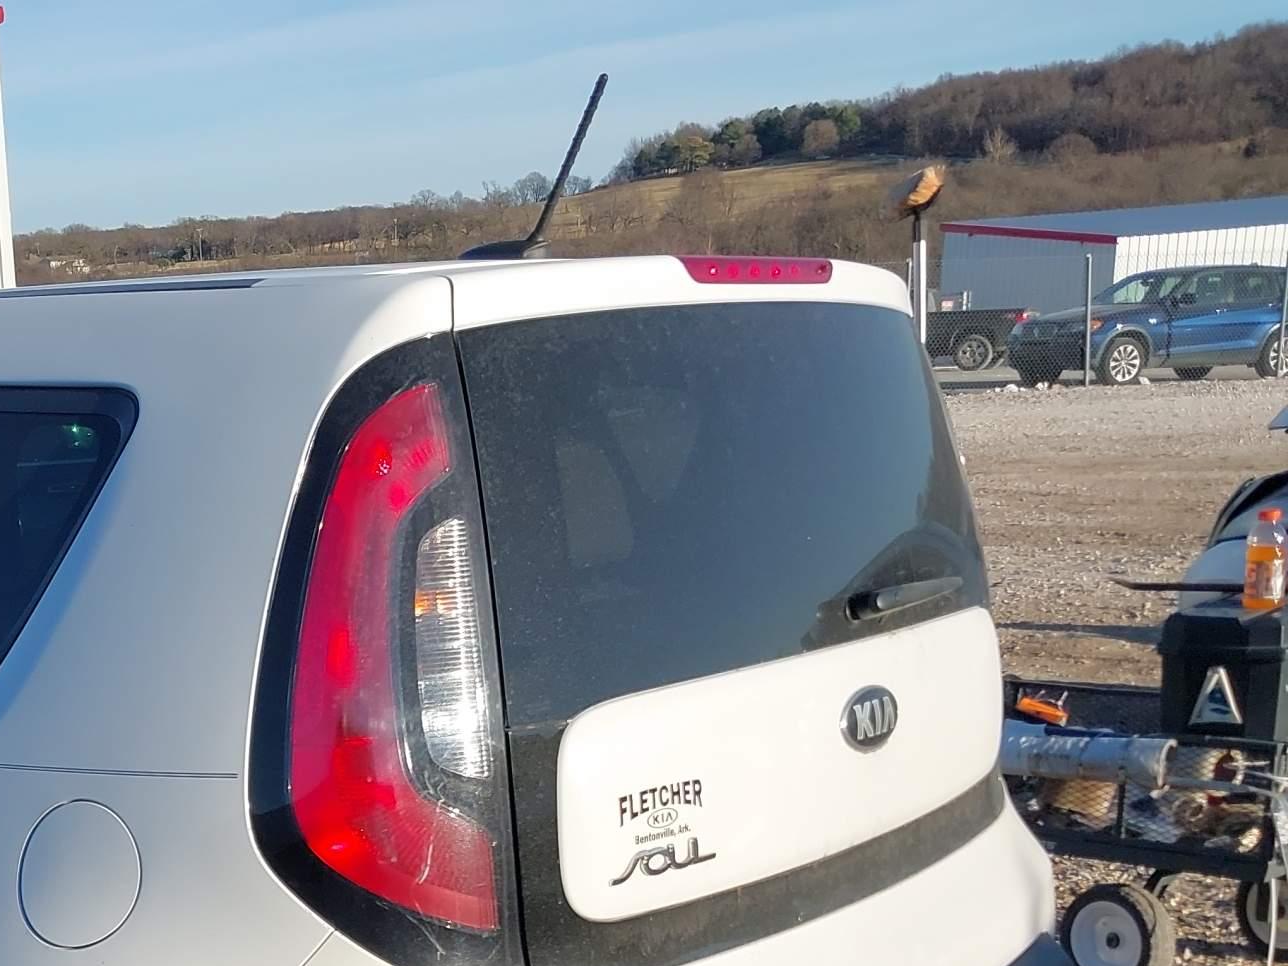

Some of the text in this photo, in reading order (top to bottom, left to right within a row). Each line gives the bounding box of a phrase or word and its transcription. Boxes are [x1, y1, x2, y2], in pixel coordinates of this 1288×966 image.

[853, 696, 895, 740] KIA
[618, 779, 703, 827] FLETCHER
[652, 811, 673, 825] KIA
[635, 824, 691, 845] Bentonville, Ark.
[609, 837, 716, 887] SOUL
